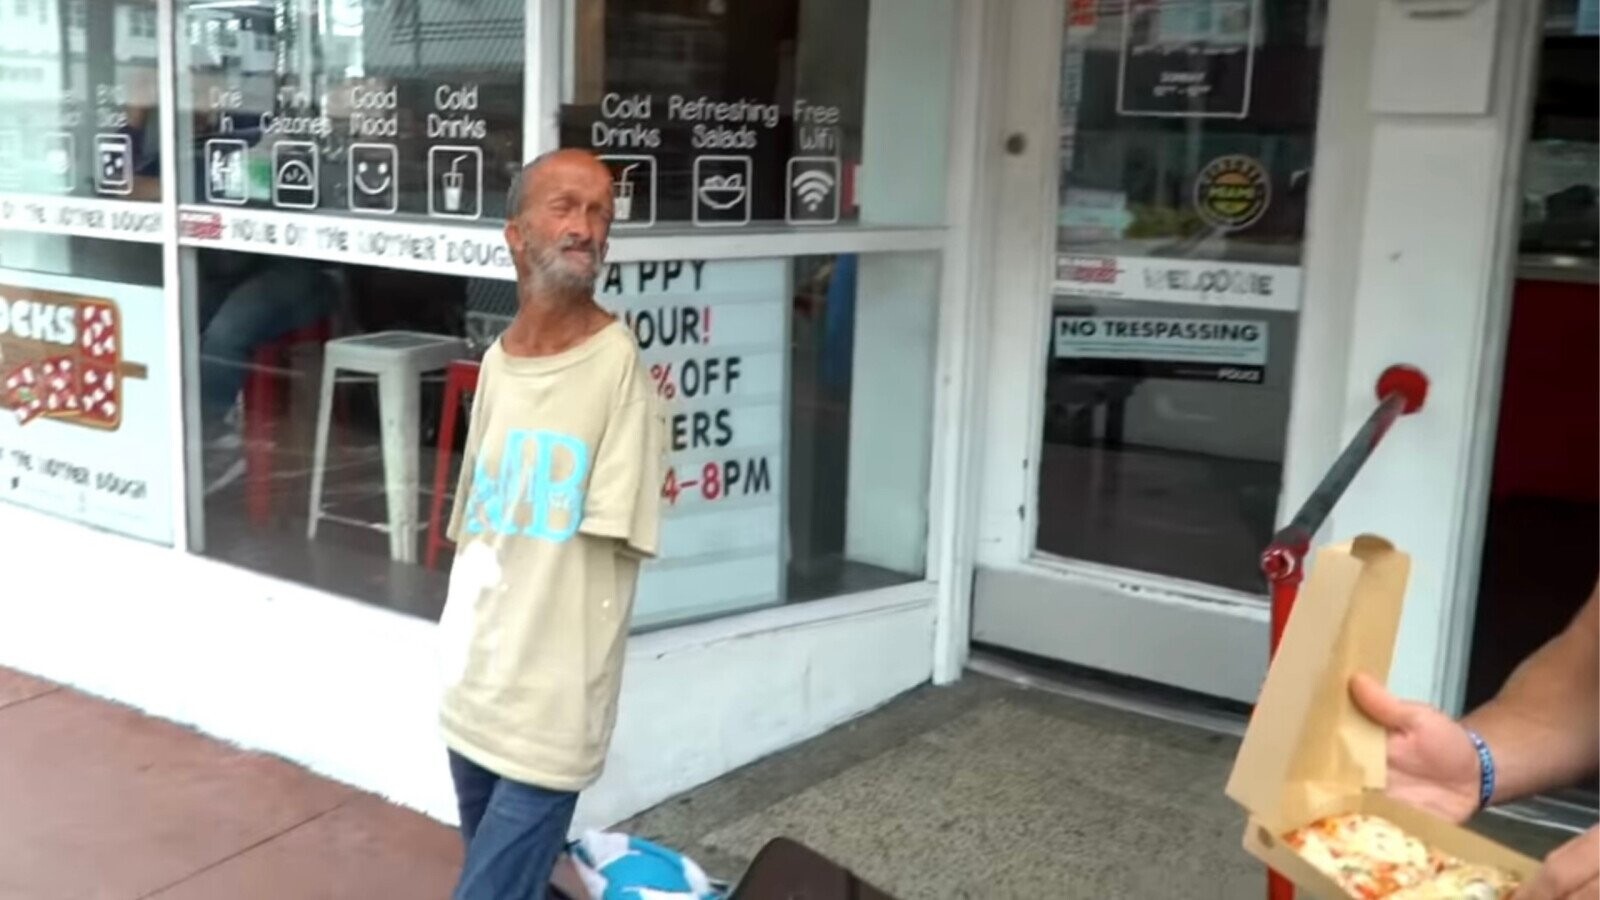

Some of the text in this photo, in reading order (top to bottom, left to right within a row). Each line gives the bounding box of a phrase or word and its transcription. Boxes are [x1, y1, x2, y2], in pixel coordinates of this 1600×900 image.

[350, 85, 397, 109] Good
[435, 85, 478, 110] Cold
[601, 93, 650, 119] Cold
[668, 96, 779, 126] Refreshing
[793, 100, 839, 124] Free
[427, 115, 485, 139] Drinks
[592, 122, 661, 147] Drinks
[692, 126, 757, 149] Salads
[602, 258, 706, 294] APPY
[1143, 268, 1273, 296] WELCOME
[624, 305, 712, 350] OUR!
[1061, 320, 1259, 342] NO TRESPASSING
[671, 408, 734, 452] ERS
